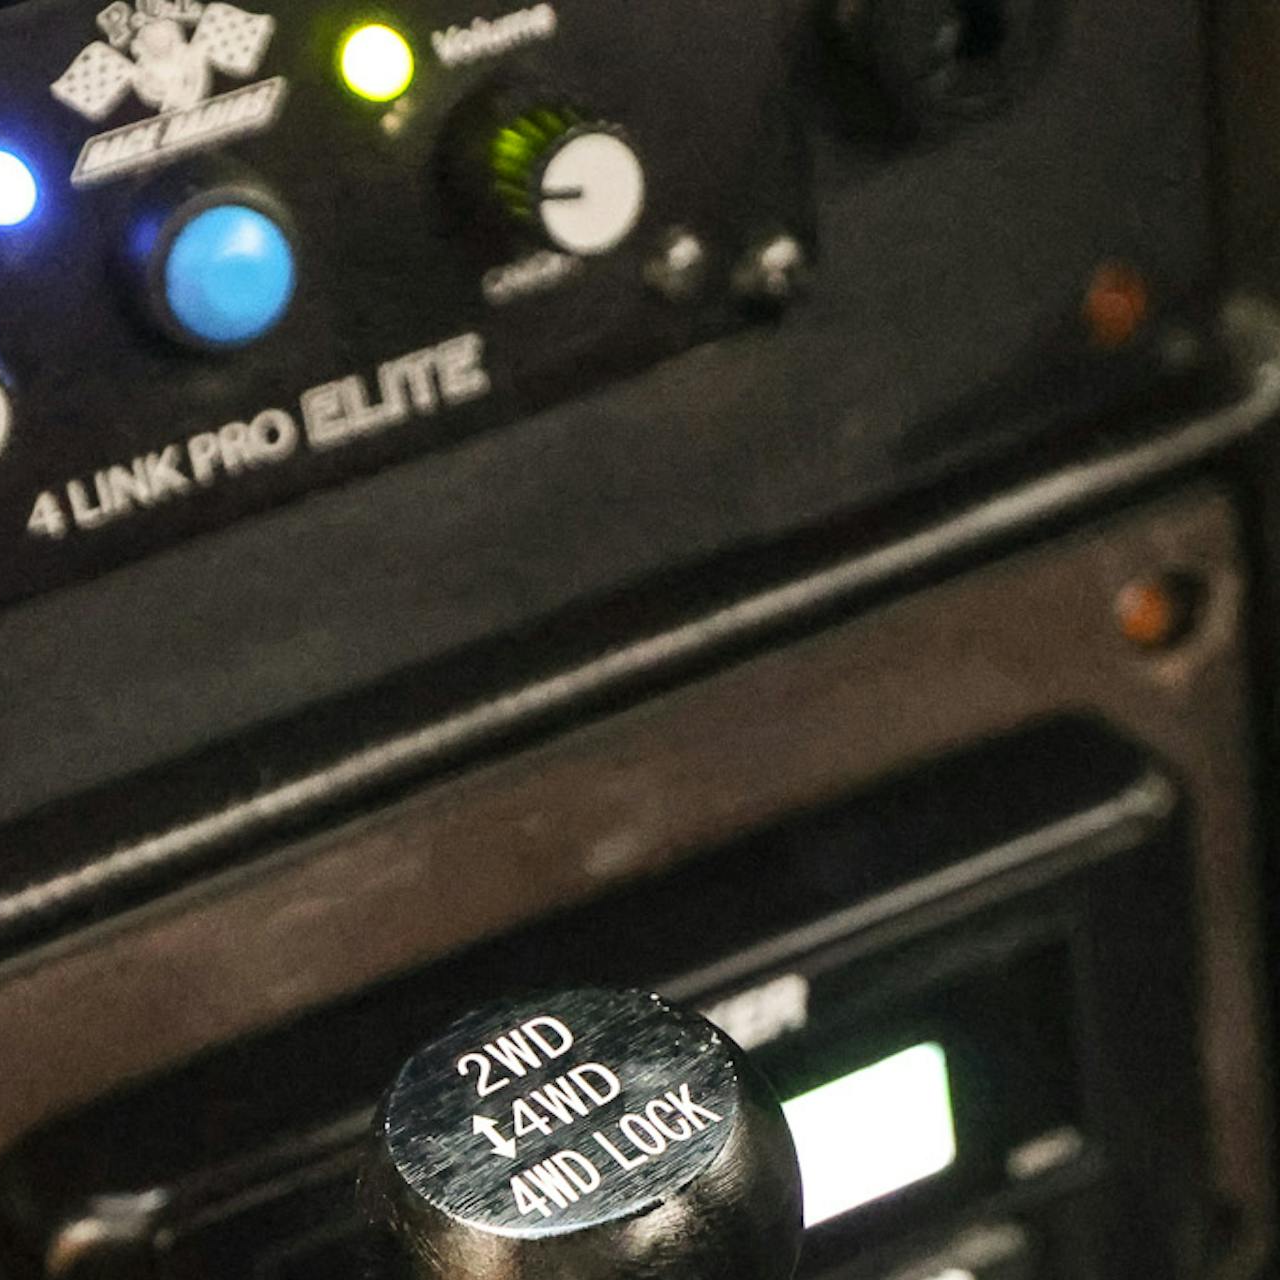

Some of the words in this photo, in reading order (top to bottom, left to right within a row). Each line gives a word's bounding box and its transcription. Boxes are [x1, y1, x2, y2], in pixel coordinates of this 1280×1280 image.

[27, 490, 67, 539] 4
[66, 444, 193, 530] LINK
[187, 408, 300, 488] PRO
[300, 332, 492, 450] ELITE
[457, 1015, 574, 1098] 2WD
[511, 1062, 621, 1137] 4WD
[509, 1149, 601, 1218] 4WD
[593, 1083, 723, 1172] LOCK
